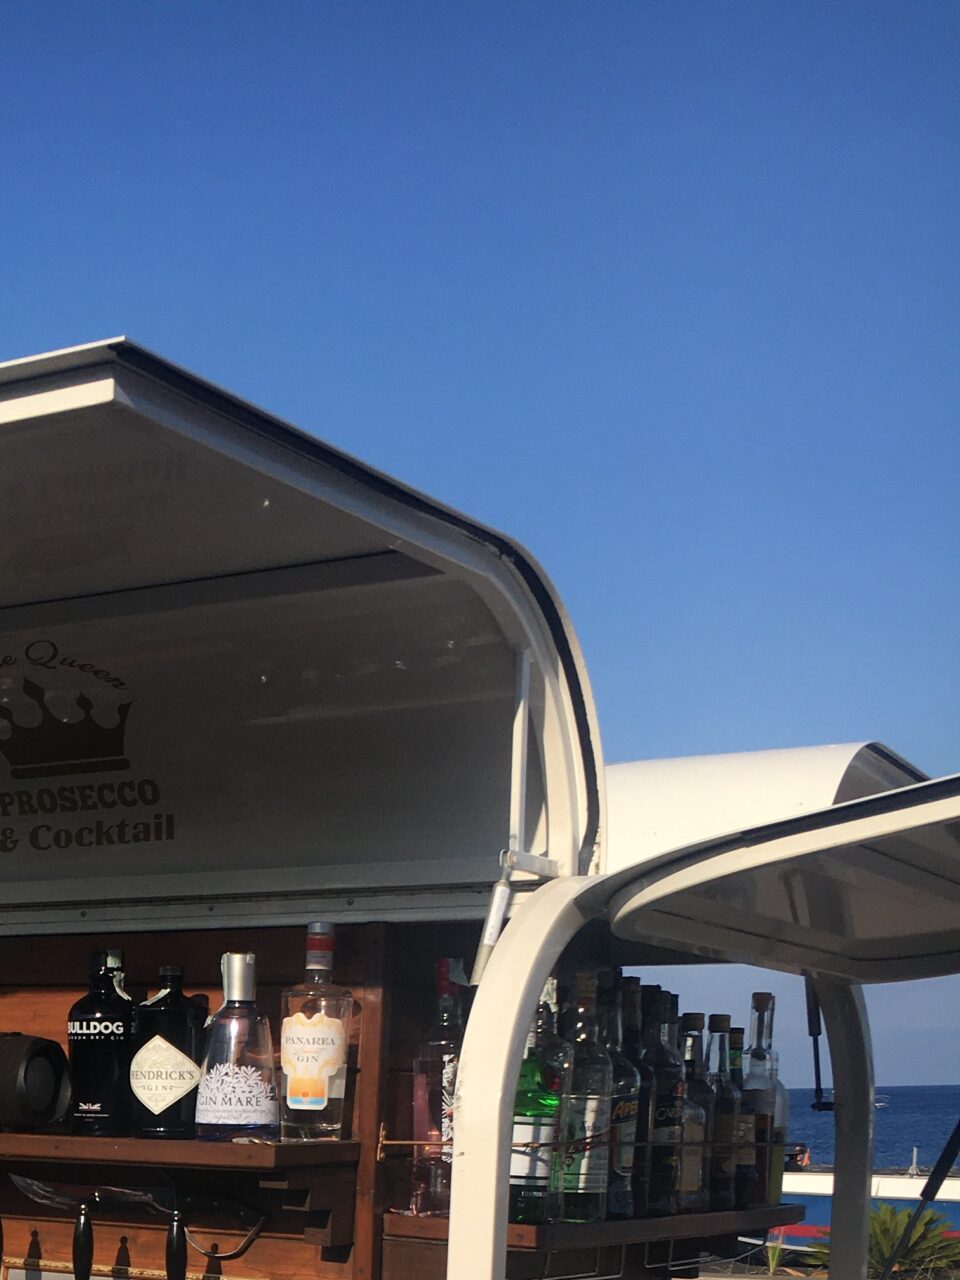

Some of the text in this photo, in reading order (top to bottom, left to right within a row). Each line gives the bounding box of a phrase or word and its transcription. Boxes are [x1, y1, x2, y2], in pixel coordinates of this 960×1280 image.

[25, 640, 127, 690] Queen
[29, 814, 175, 850] Cocktail
[285, 1036, 336, 1046] PANAREA
[131, 1070, 195, 1080] HENDRICK'S
[199, 1095, 263, 1107] GIN MARE
